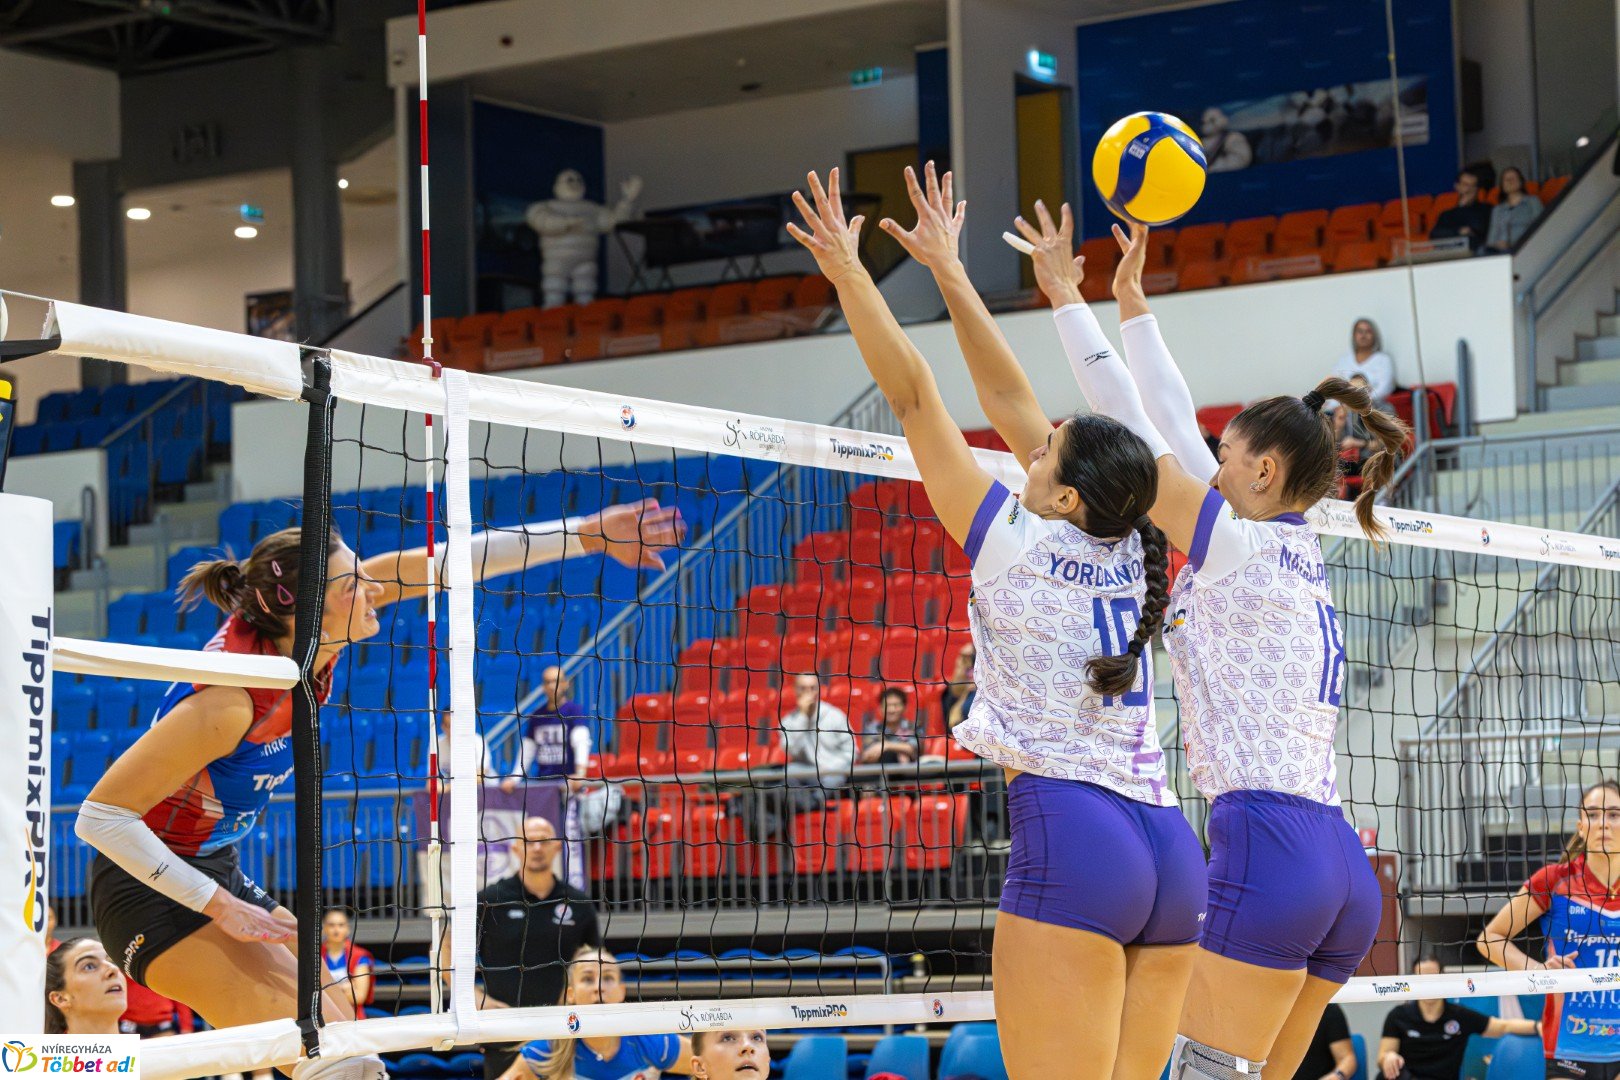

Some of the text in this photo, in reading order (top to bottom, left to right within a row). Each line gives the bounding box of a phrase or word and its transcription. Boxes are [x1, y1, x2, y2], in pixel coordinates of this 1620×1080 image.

[829, 438, 894, 461] TippmixPRO
[1050, 552, 1144, 588] YORDANO
[1093, 597, 1149, 707] 10
[1064, 687, 1078, 698] UTE
[22, 606, 51, 933] TippmixPRO
[791, 1004, 848, 1021] TippmixPRO
